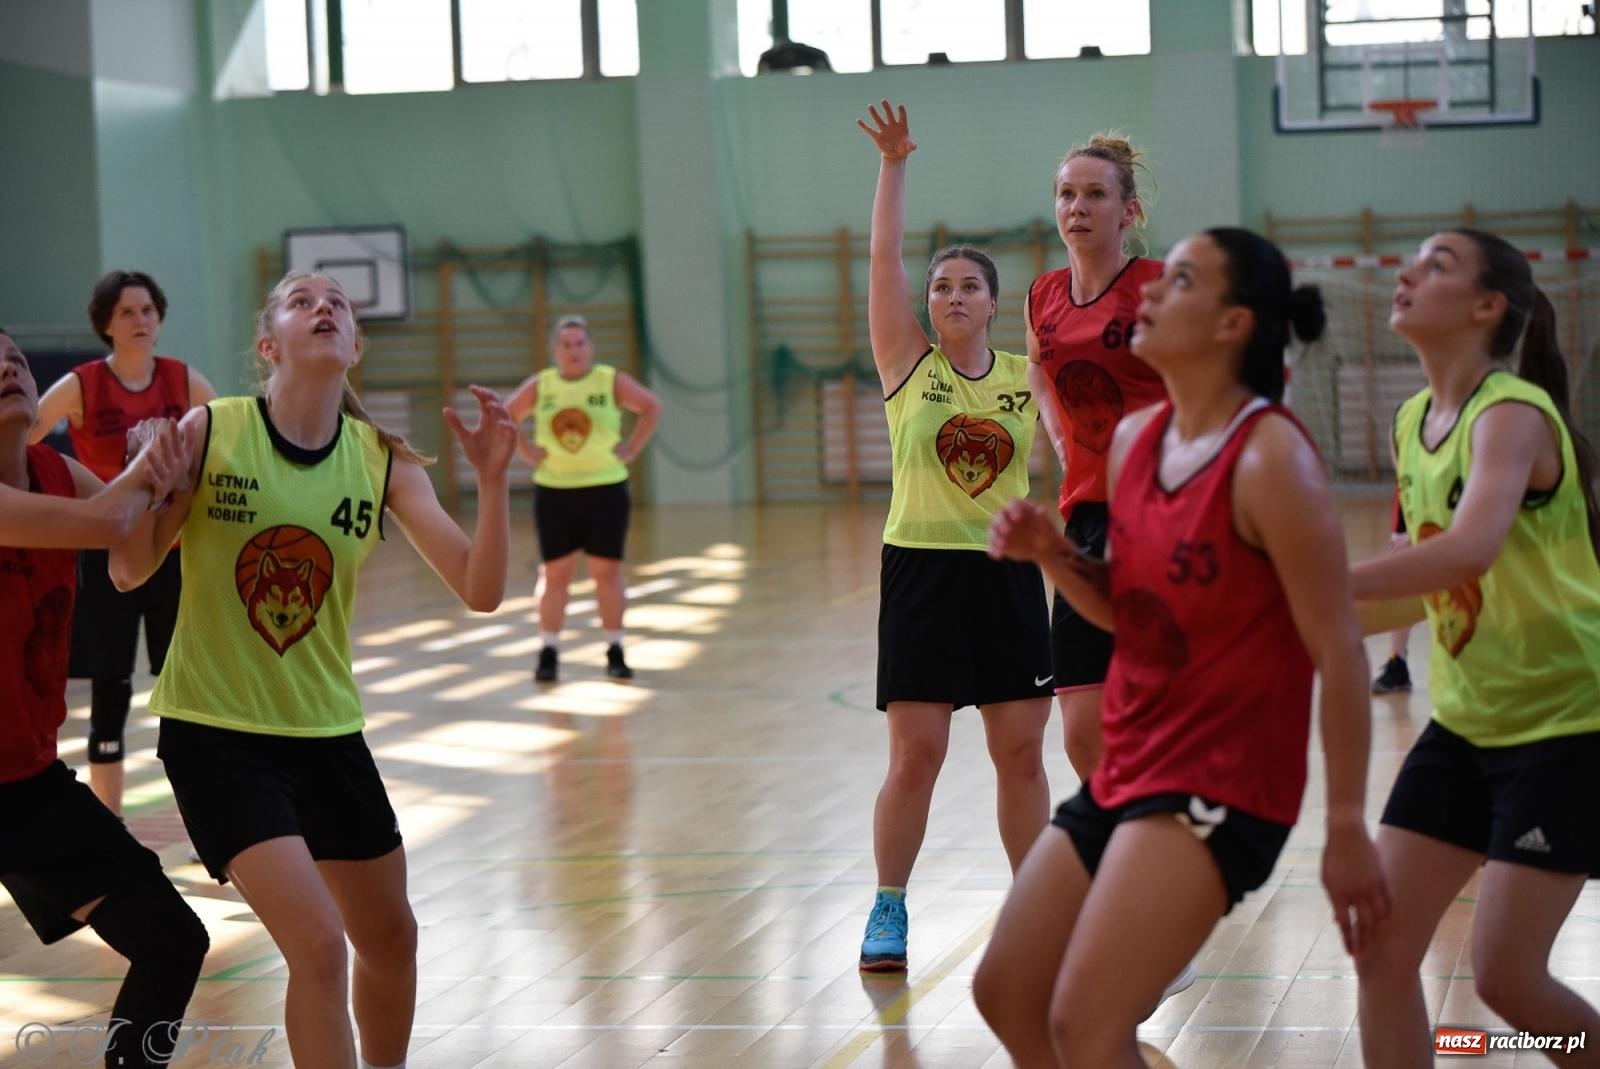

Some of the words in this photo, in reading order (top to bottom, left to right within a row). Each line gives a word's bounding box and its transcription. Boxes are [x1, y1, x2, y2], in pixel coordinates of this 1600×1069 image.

[922, 391, 952, 404] KOBIE
[997, 391, 1032, 413] 37
[208, 472, 260, 491] LETNIA
[215, 491, 247, 506] LIGA
[207, 506, 258, 524] KOBIET
[331, 497, 373, 539] 45
[1168, 540, 1220, 585] 53
